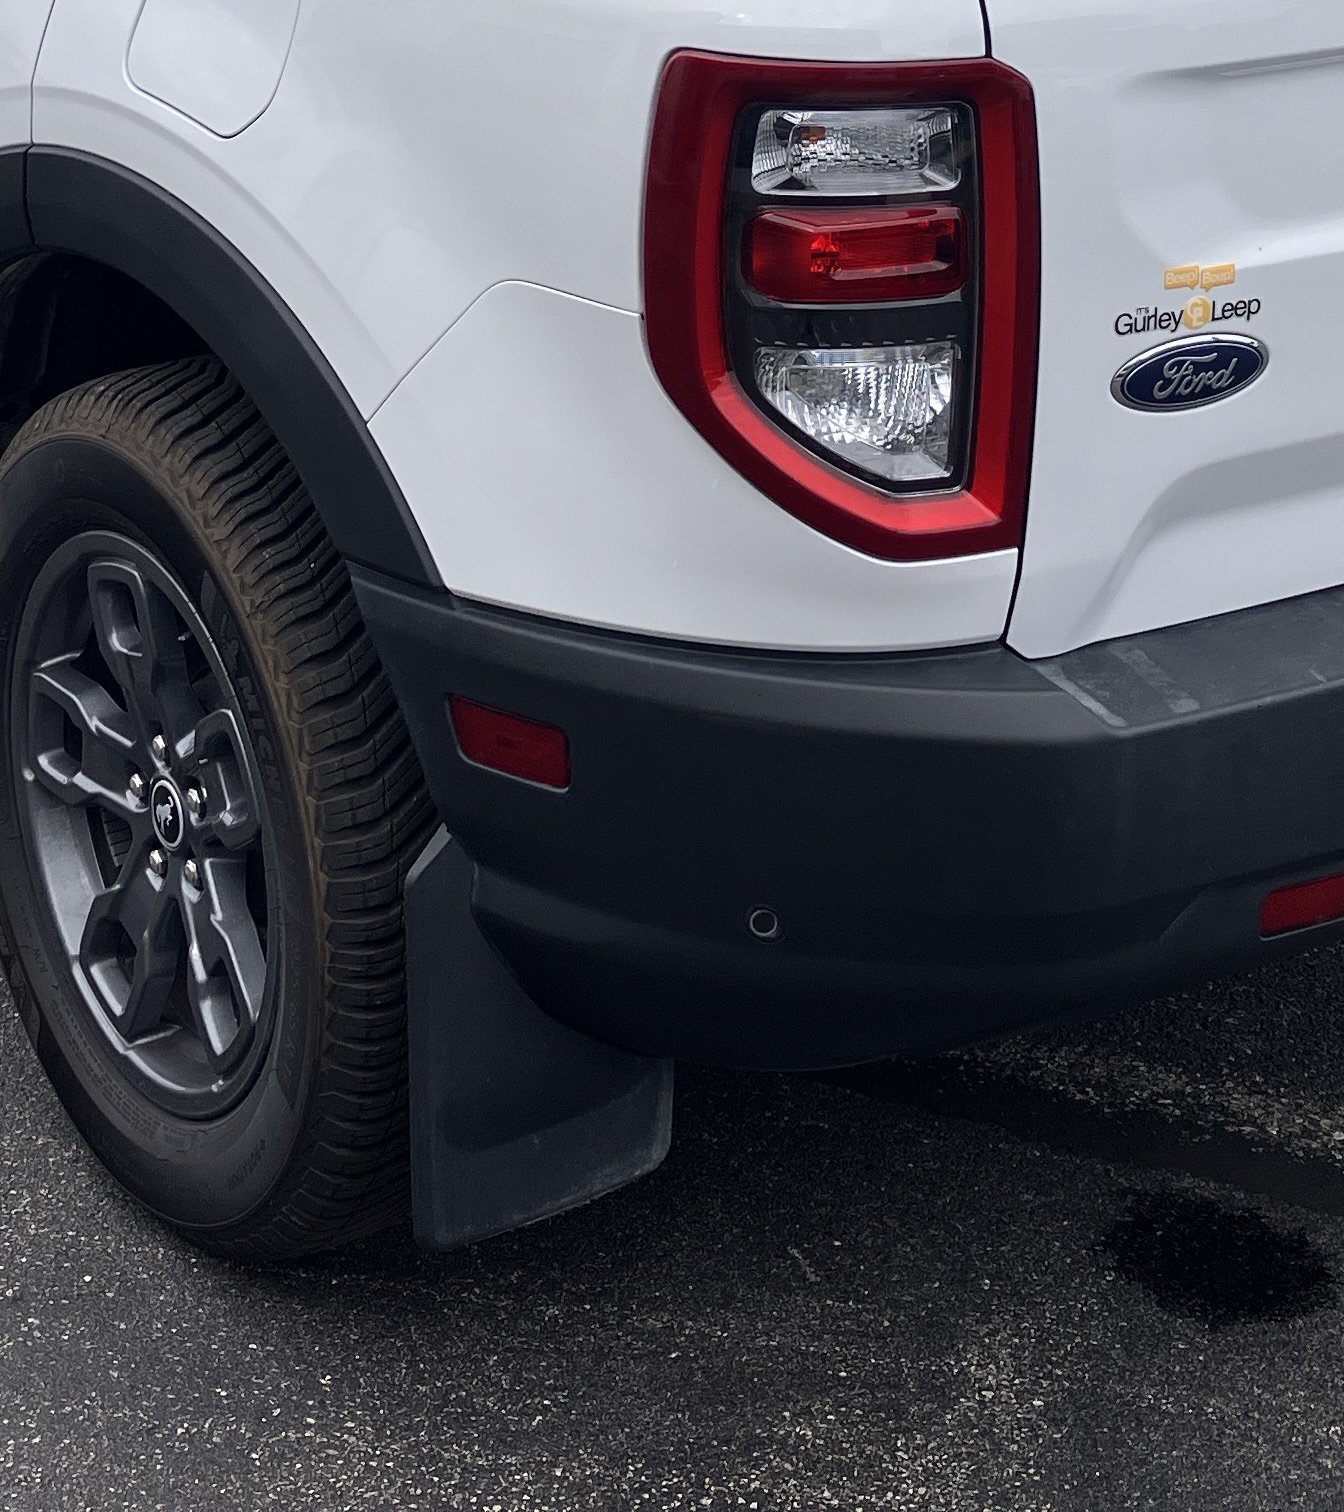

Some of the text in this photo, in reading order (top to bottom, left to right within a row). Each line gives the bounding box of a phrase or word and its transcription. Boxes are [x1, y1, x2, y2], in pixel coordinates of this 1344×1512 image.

[1115, 306, 1185, 336] Gurley
[1211, 297, 1261, 322] Leep
[1153, 352, 1238, 400] Ford
